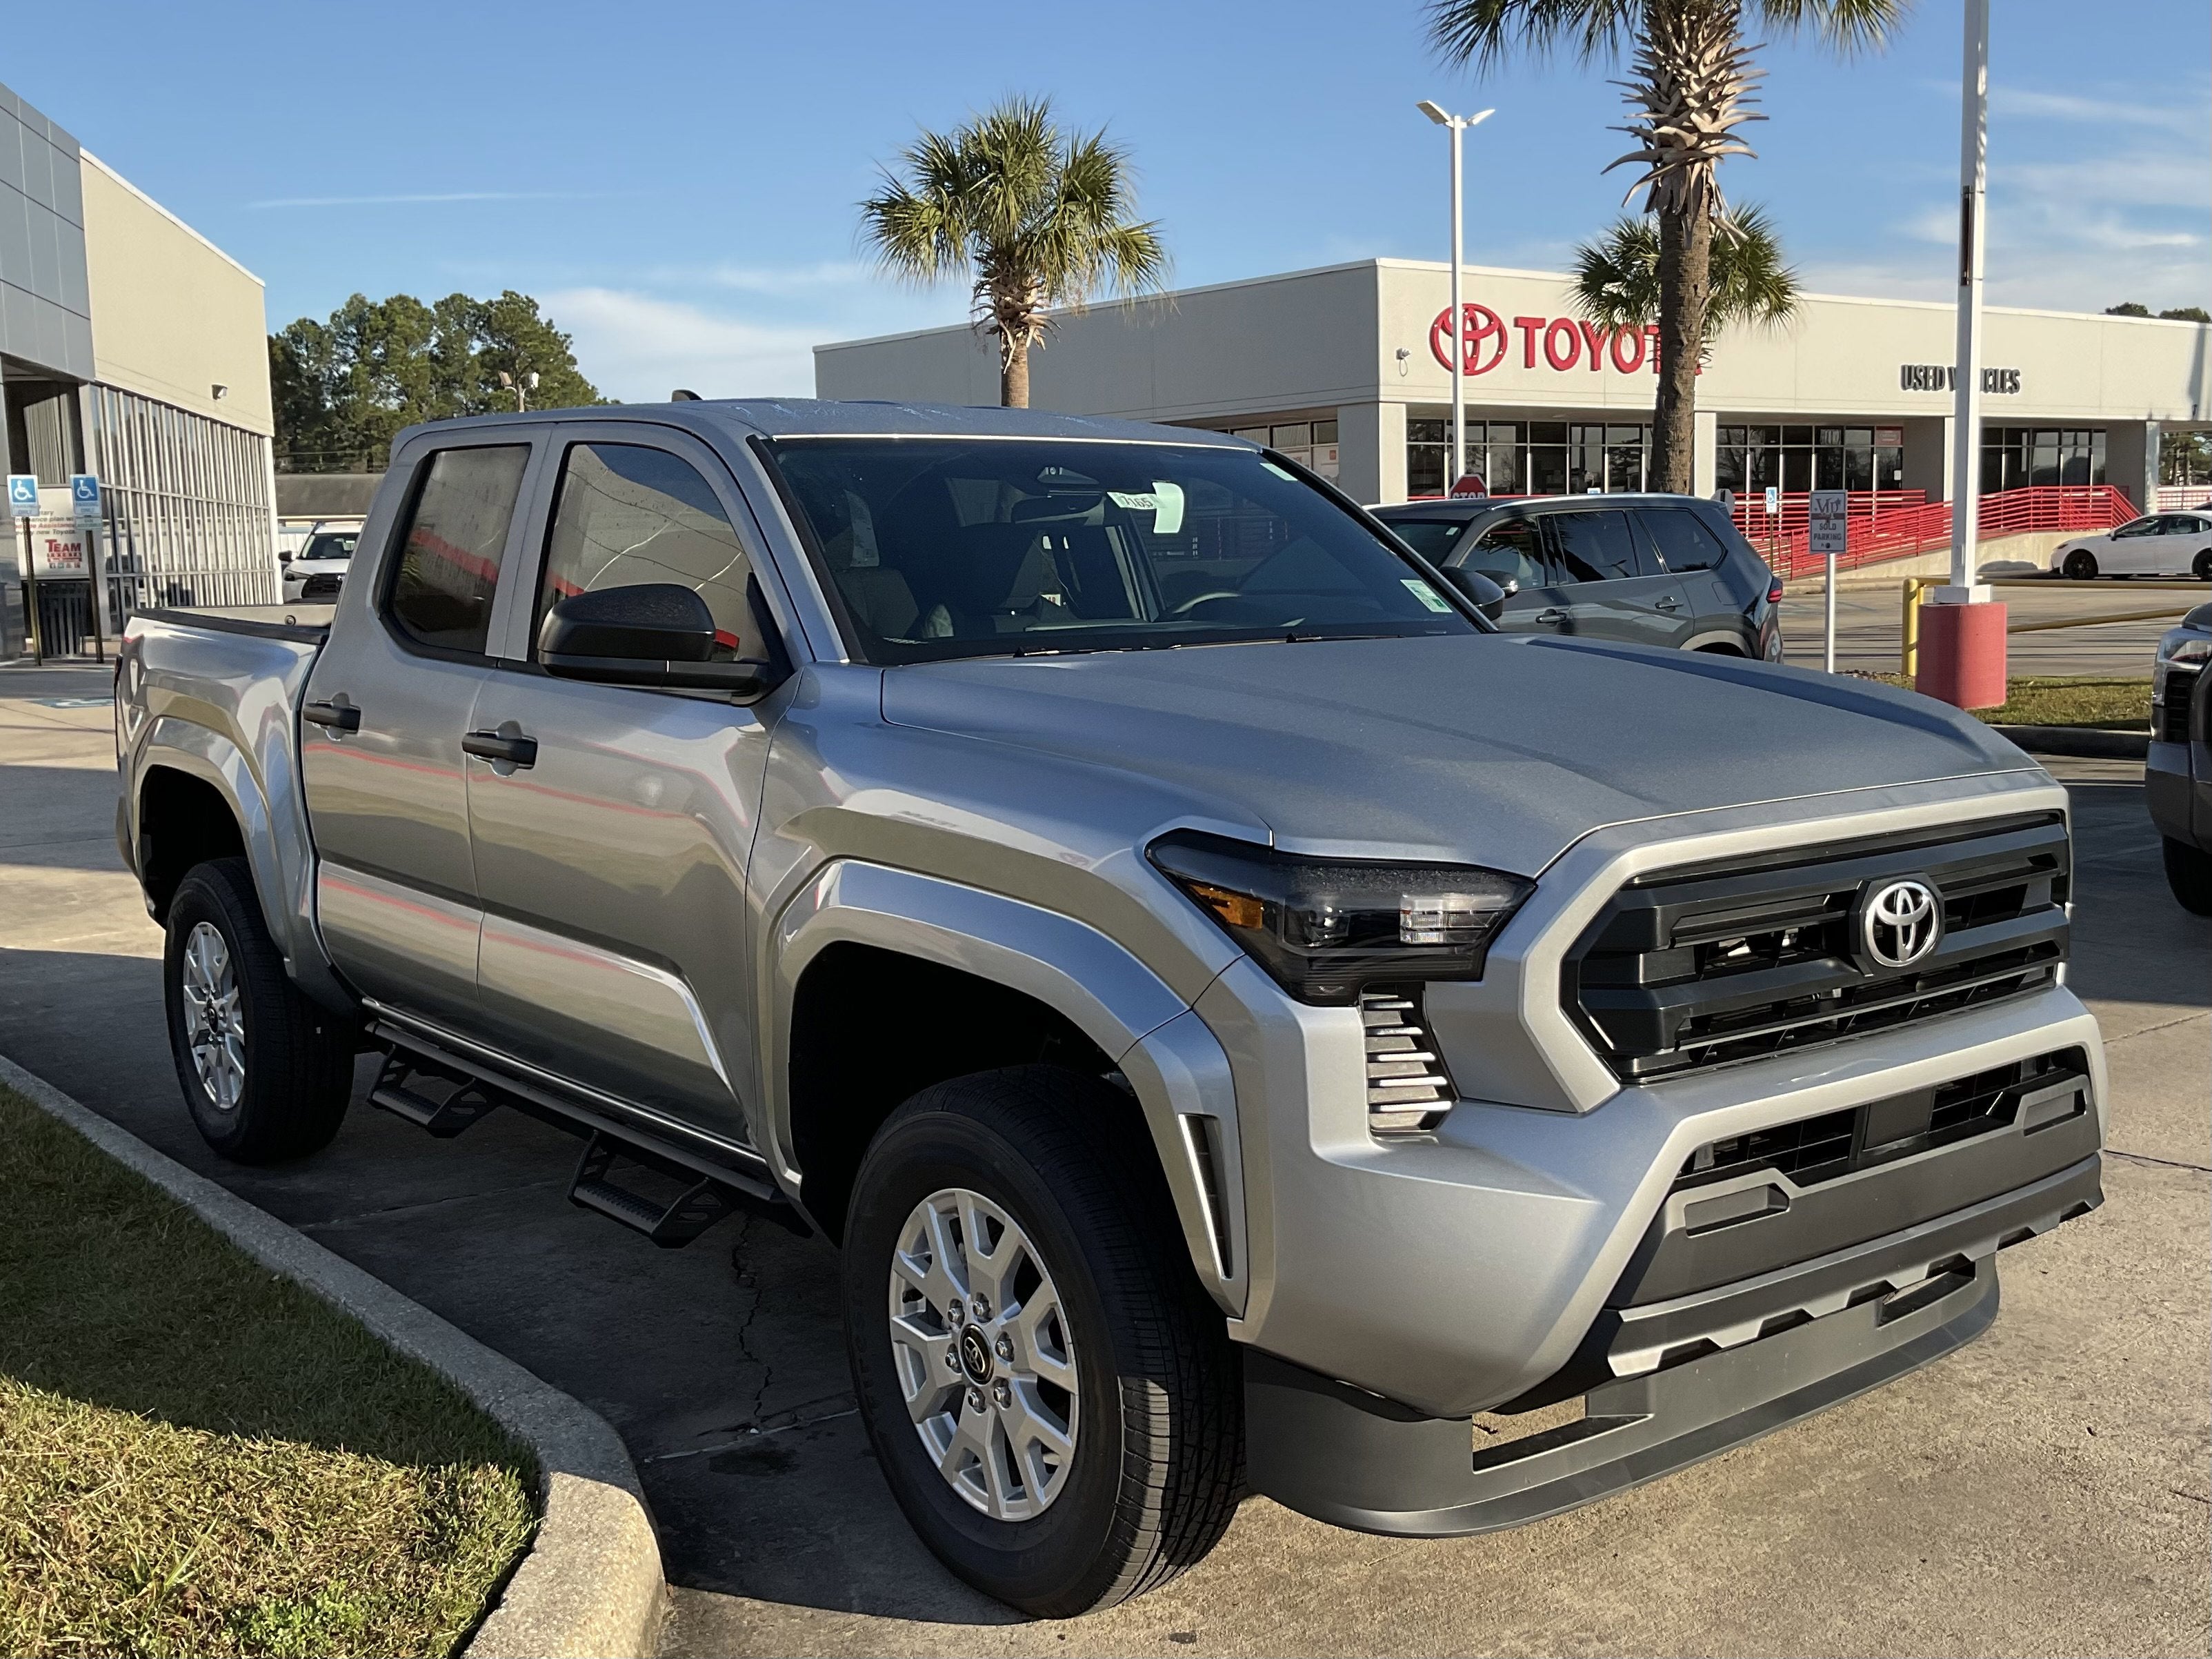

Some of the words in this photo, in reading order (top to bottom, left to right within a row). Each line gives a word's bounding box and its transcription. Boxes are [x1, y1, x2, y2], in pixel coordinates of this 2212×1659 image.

[1514, 316, 1702, 375] TOYOT
[1901, 364, 1946, 391] USED
[1947, 366, 2021, 394] VICLES
